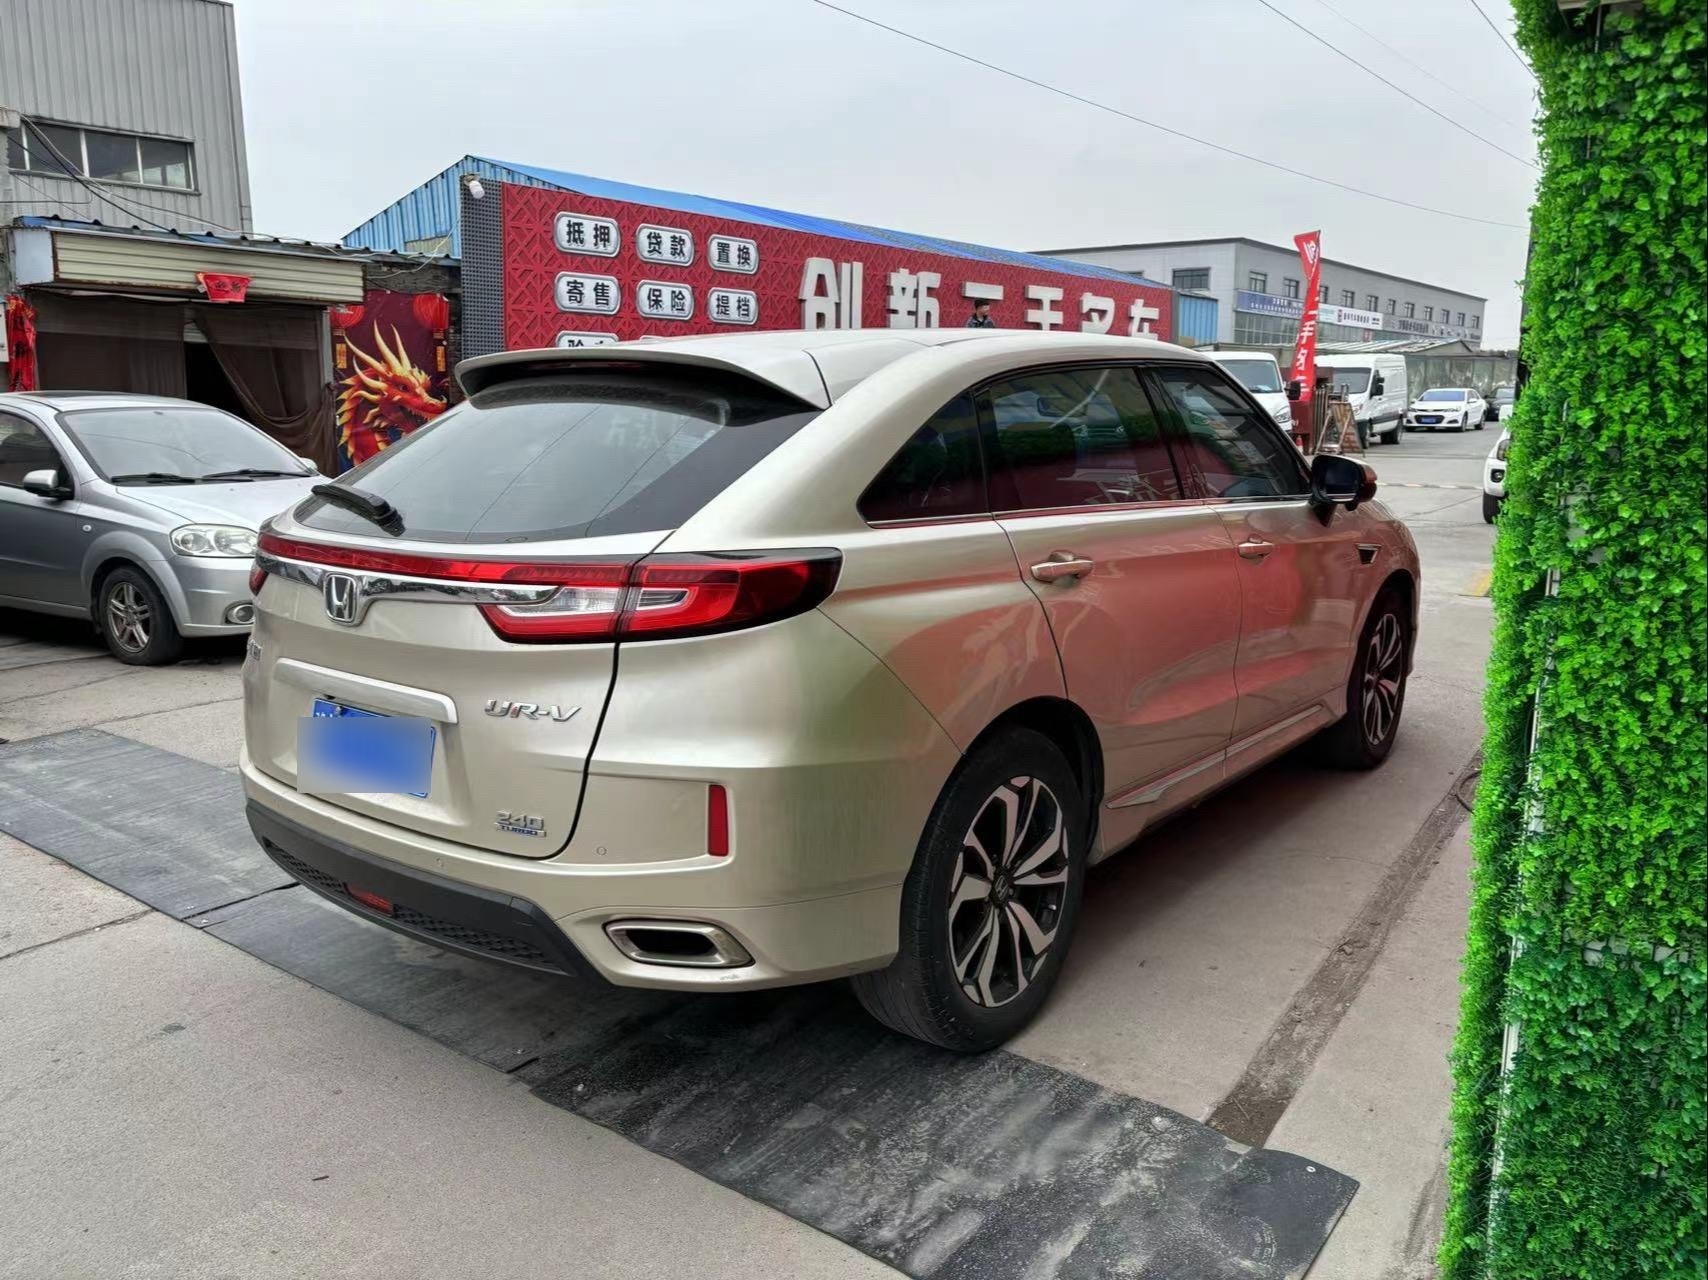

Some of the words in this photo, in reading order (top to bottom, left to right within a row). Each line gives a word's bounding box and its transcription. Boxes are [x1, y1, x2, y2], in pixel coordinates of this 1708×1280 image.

[566, 220, 611, 249] 抵押
[646, 231, 687, 258] 贷款
[716, 241, 751, 266] 置换
[566, 279, 611, 307] 寄售
[647, 287, 686, 313] 保险
[715, 294, 751, 318] 提档
[484, 699, 582, 722] UR-V
[496, 810, 545, 830] 240
